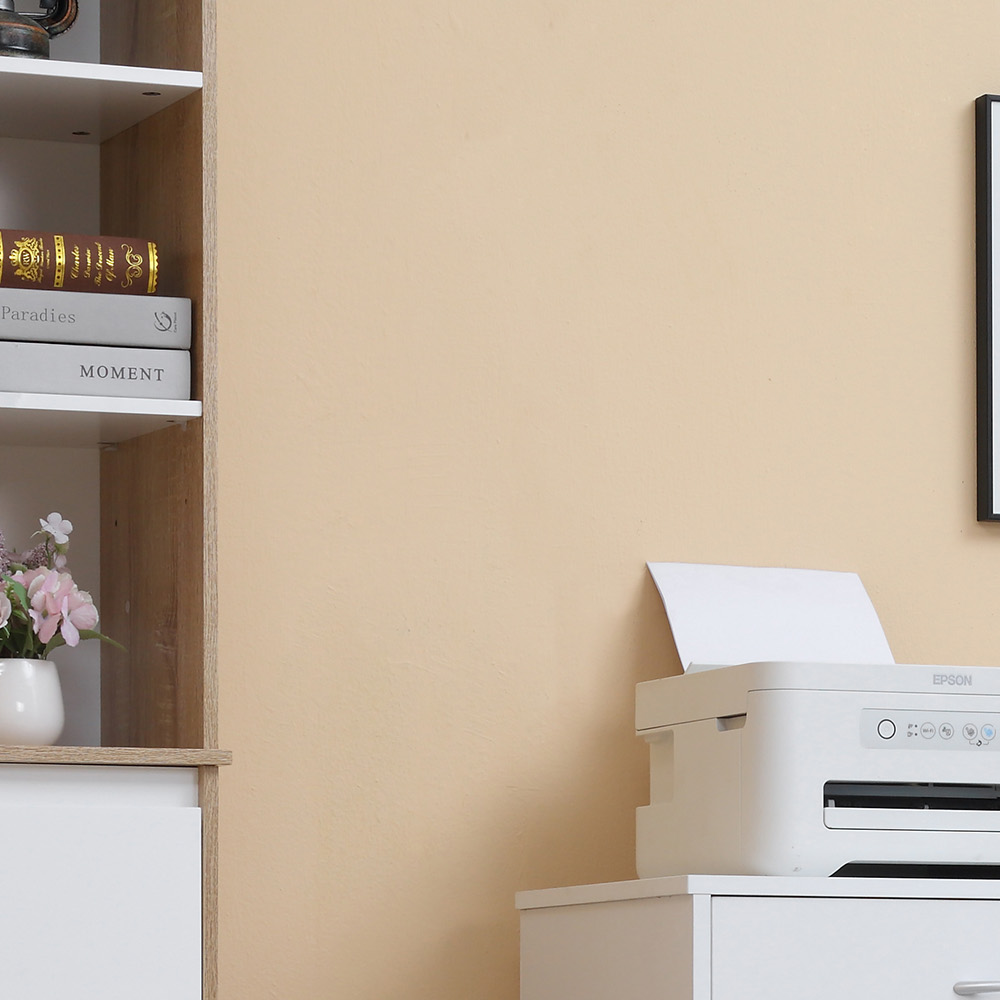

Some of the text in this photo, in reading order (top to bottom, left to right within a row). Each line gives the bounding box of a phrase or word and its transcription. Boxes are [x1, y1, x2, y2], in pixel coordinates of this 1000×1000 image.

[69, 244, 81, 280] Charles
[1, 305, 77, 324] Paradies
[79, 364, 165, 382] MOMENT
[932, 673, 973, 687] EPSON
